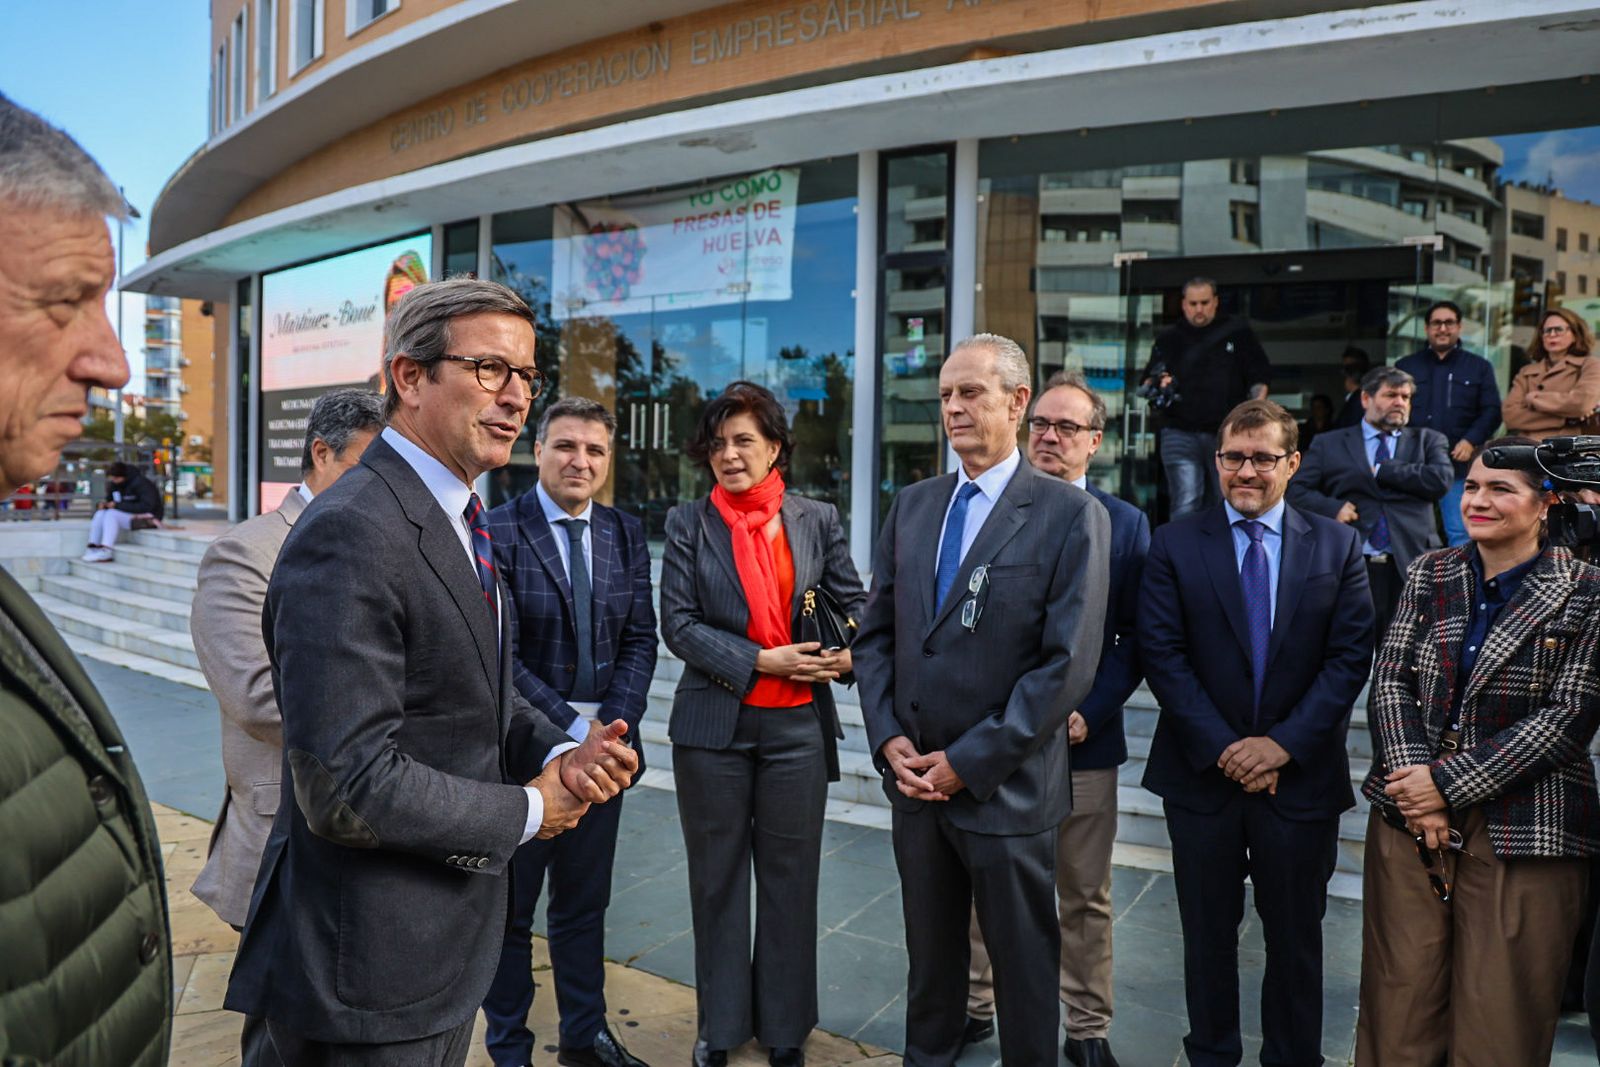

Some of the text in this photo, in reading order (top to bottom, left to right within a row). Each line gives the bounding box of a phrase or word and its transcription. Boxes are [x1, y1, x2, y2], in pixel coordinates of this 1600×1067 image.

[390, 107, 455, 151] CENTRO
[463, 91, 489, 127] DE
[501, 40, 673, 115] COOPERACION
[720, 172, 782, 202] COMO
[672, 200, 782, 235] FRESAS DE
[703, 227, 782, 255] HUELVA
